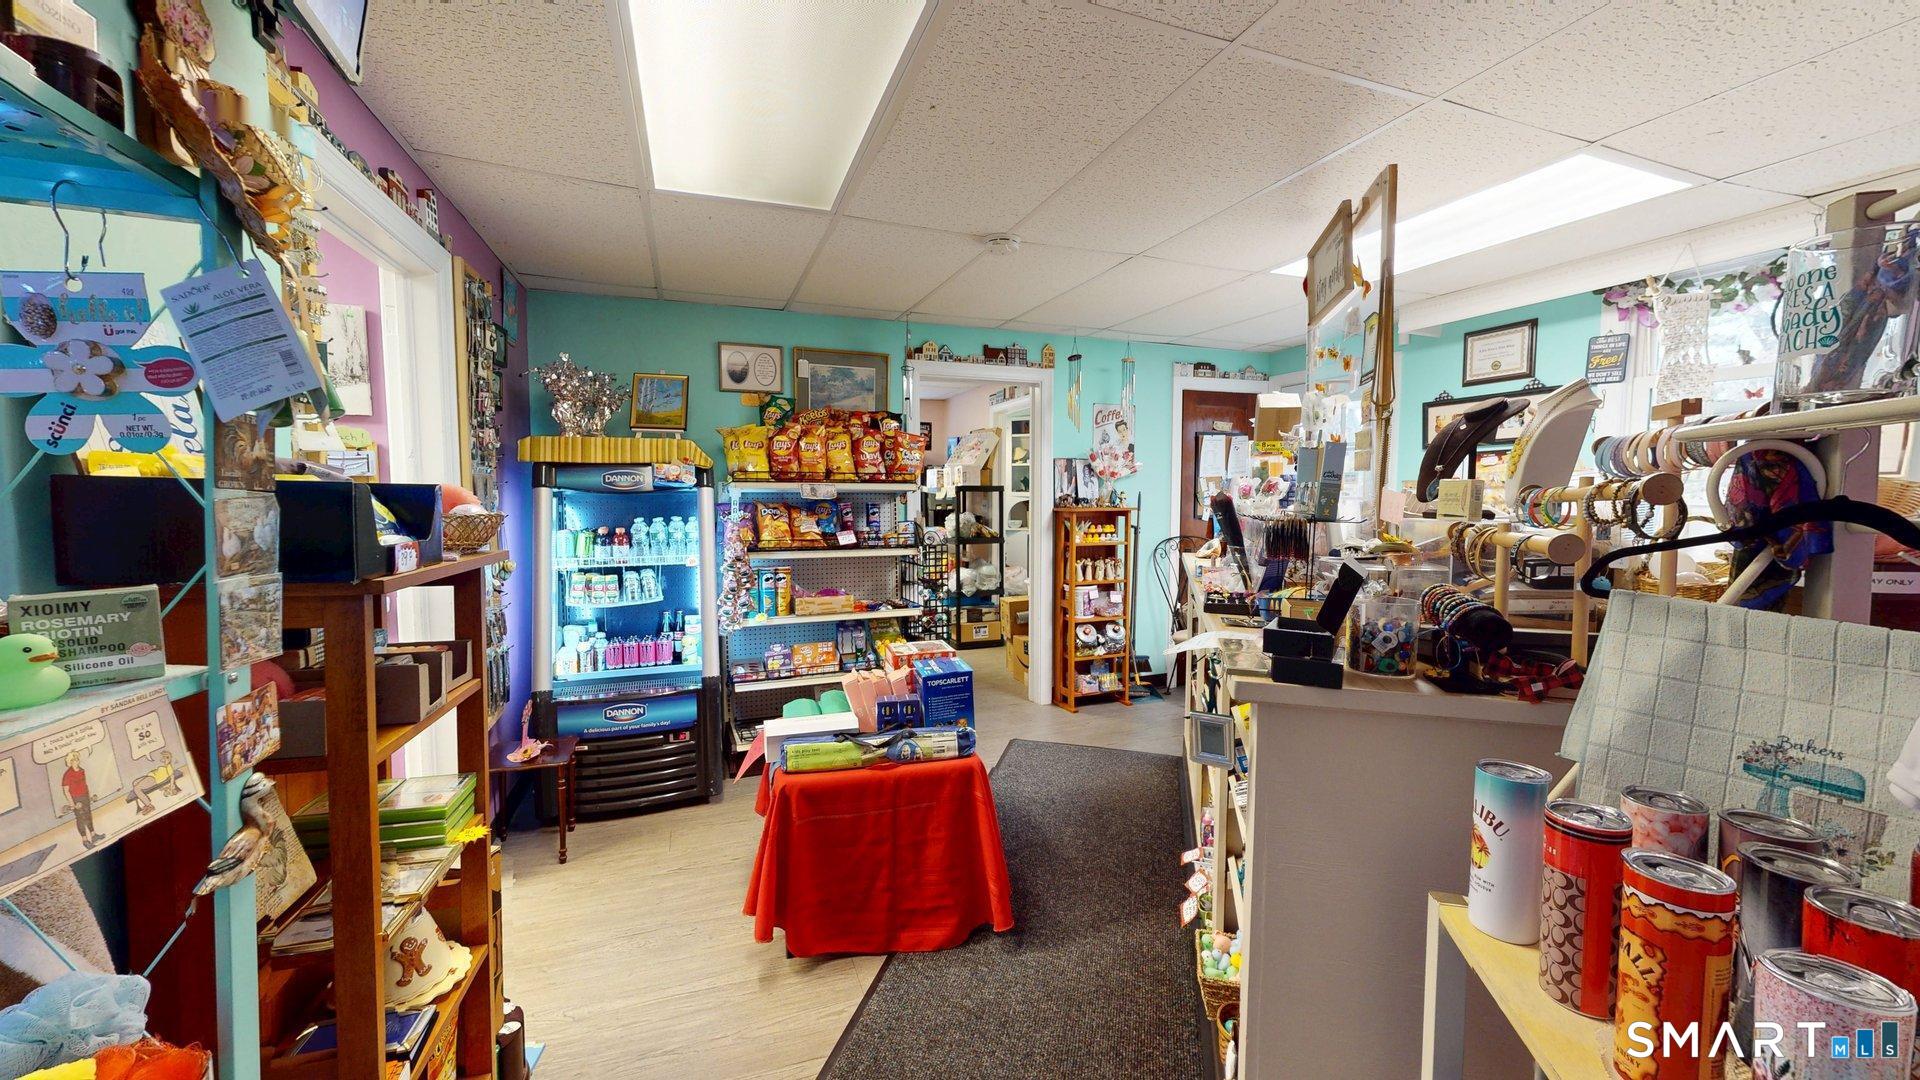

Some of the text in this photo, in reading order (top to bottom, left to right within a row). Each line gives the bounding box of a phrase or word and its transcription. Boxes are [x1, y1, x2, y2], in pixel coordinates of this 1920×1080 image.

[213, 281, 263, 300] ALOE VERA
[1589, 352, 1624, 369] Free!
[126, 425, 141, 433] NET
[605, 475, 644, 483] DANNON
[20, 600, 92, 618] XIOIMY
[20, 611, 132, 632] ROSEMARY
[57, 636, 98, 648] SOLID
[58, 642, 126, 659] SHAMPOO
[64, 656, 134, 673] Silicone Oil
[927, 675, 969, 687] TOPSCARLETT
[110, 698, 136, 712] SANDRA
[606, 707, 644, 718] DANNON
[138, 730, 151, 741] SO
[588, 726, 611, 734] delicious
[629, 723, 641, 731] your
[1777, 734, 1844, 761] Bakers
